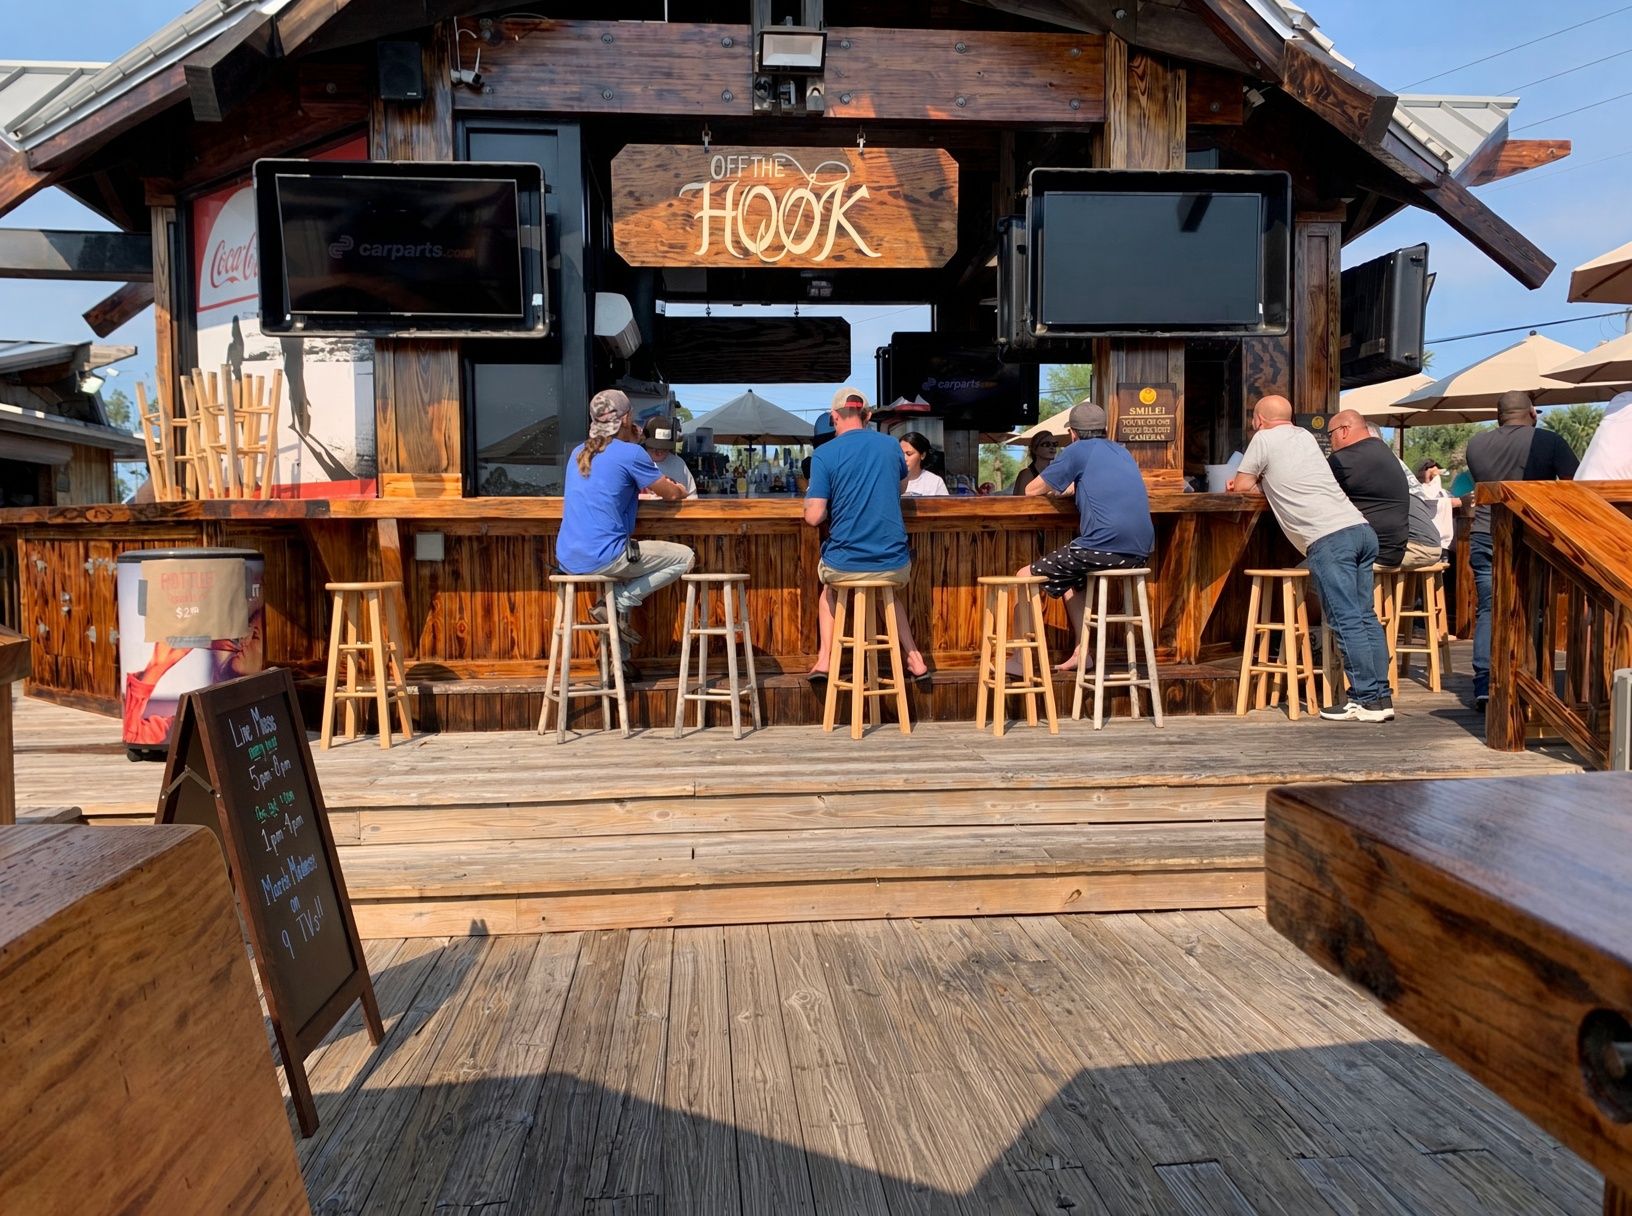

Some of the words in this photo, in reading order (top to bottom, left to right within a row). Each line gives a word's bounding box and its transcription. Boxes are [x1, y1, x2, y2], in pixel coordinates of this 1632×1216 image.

[710, 155, 749, 180] OFF
[750, 156, 786, 178] THE
[679, 180, 882, 262] HOOK
[210, 231, 258, 288] Coca-Co
[937, 379, 998, 391] carparts
